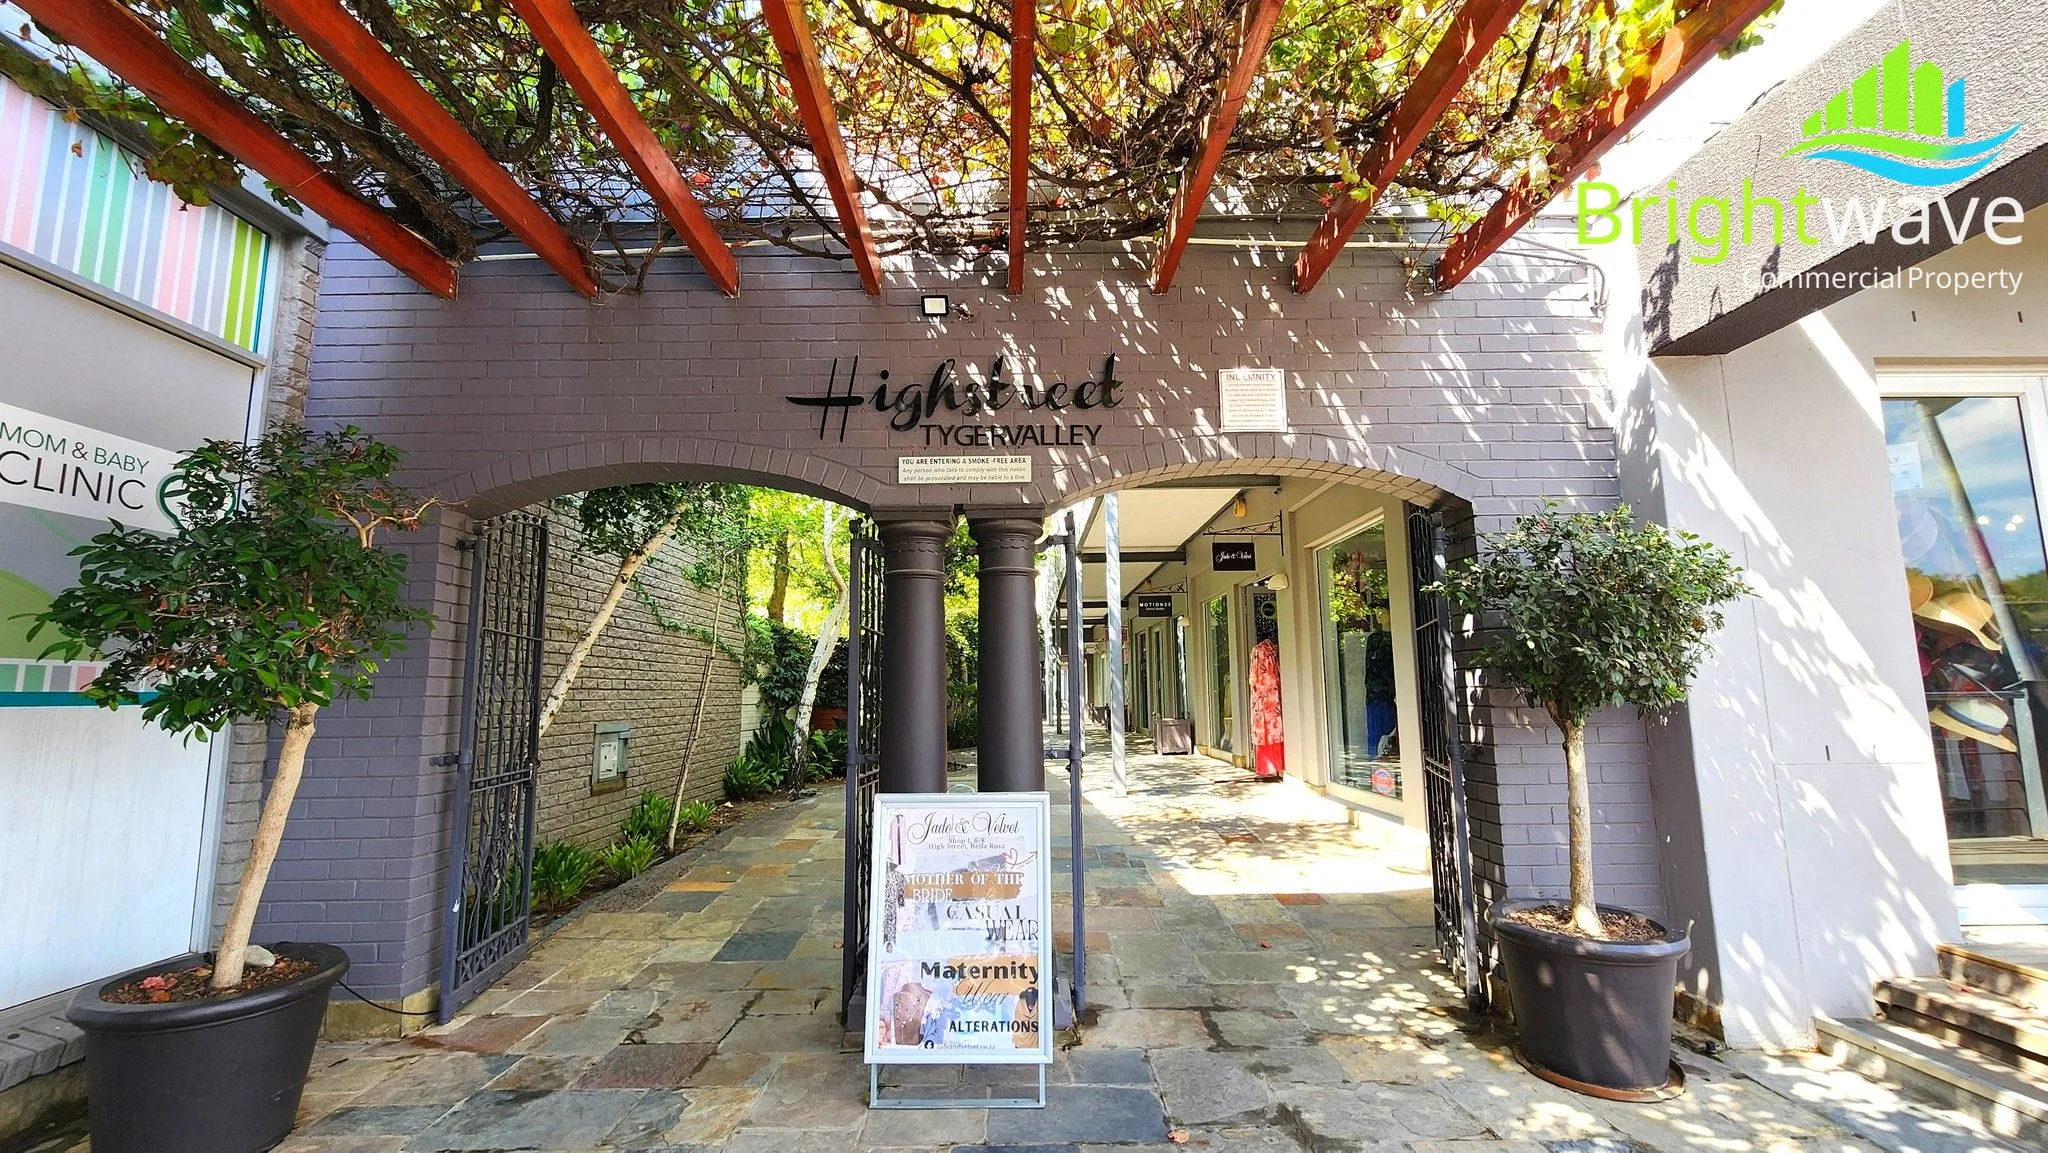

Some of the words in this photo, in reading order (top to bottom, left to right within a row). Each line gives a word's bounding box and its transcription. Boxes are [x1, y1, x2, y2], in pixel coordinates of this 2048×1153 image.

[785, 352, 1125, 443] Highstreet
[919, 424, 1103, 447] TYGERVALLEY
[0, 422, 66, 455] MOM
[72, 441, 88, 461] &
[94, 447, 150, 475] BABY
[0, 450, 146, 510] CLINIC
[907, 811, 954, 845] Jade
[955, 817, 970, 834] &
[972, 811, 1019, 836] Velvet
[948, 837, 966, 845] Shop
[904, 873, 964, 885] MOTHER
[970, 873, 988, 885] OF
[912, 888, 953, 901] BRIDE
[946, 904, 1026, 920] CASUAL
[985, 919, 1039, 941] WEAR
[920, 961, 1039, 984] Maternity
[955, 979, 1009, 1006] Wear
[948, 1020, 1039, 1033] ALTERATIONS
